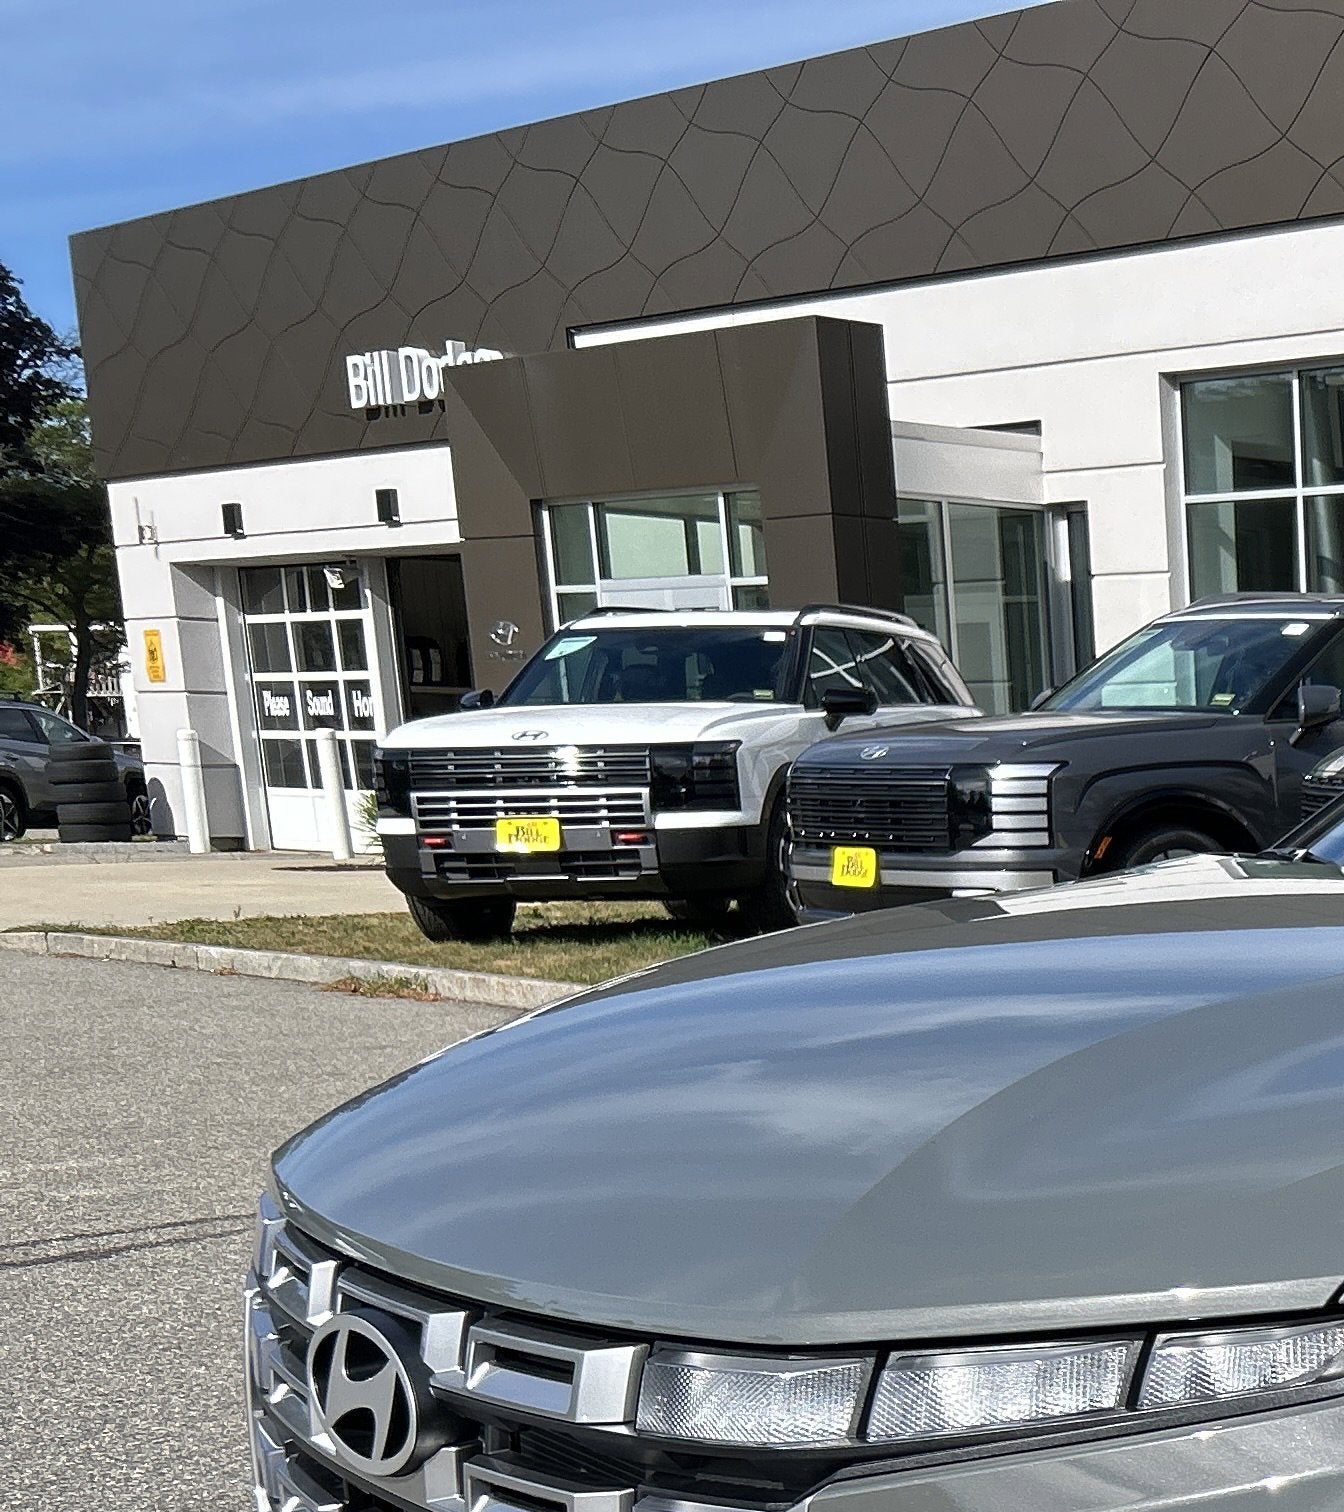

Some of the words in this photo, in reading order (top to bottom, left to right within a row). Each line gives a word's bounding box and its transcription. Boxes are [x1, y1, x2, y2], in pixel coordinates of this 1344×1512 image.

[346, 350, 395, 408] Bill
[262, 690, 290, 716] Please
[306, 689, 334, 716] Sound
